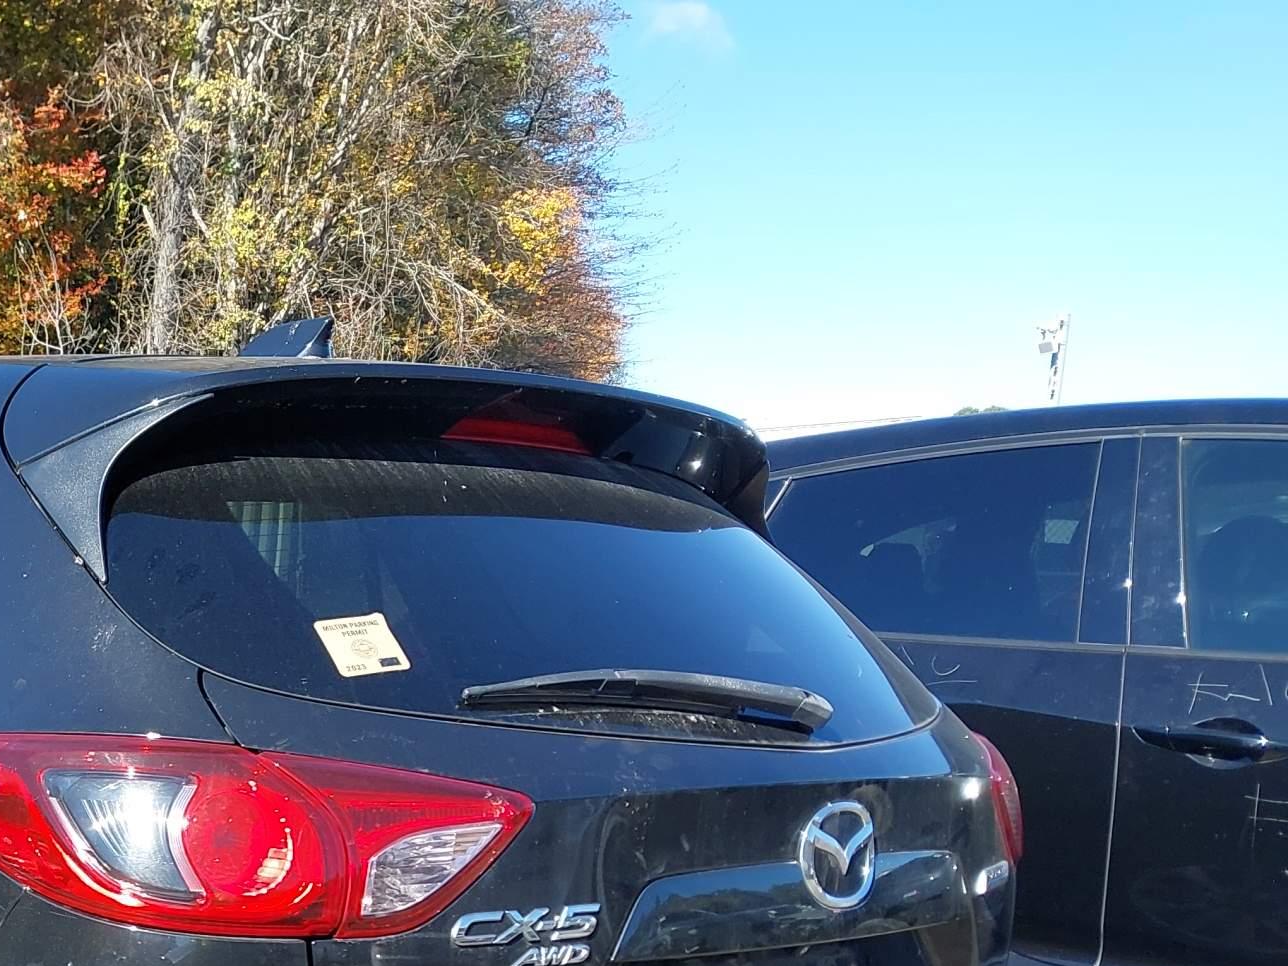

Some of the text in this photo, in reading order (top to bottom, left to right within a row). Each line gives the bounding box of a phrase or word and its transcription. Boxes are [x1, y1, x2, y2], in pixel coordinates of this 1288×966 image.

[322, 619, 379, 632] MILTON PARKING
[341, 628, 368, 637] PERMIT
[450, 903, 601, 947] CX-5
